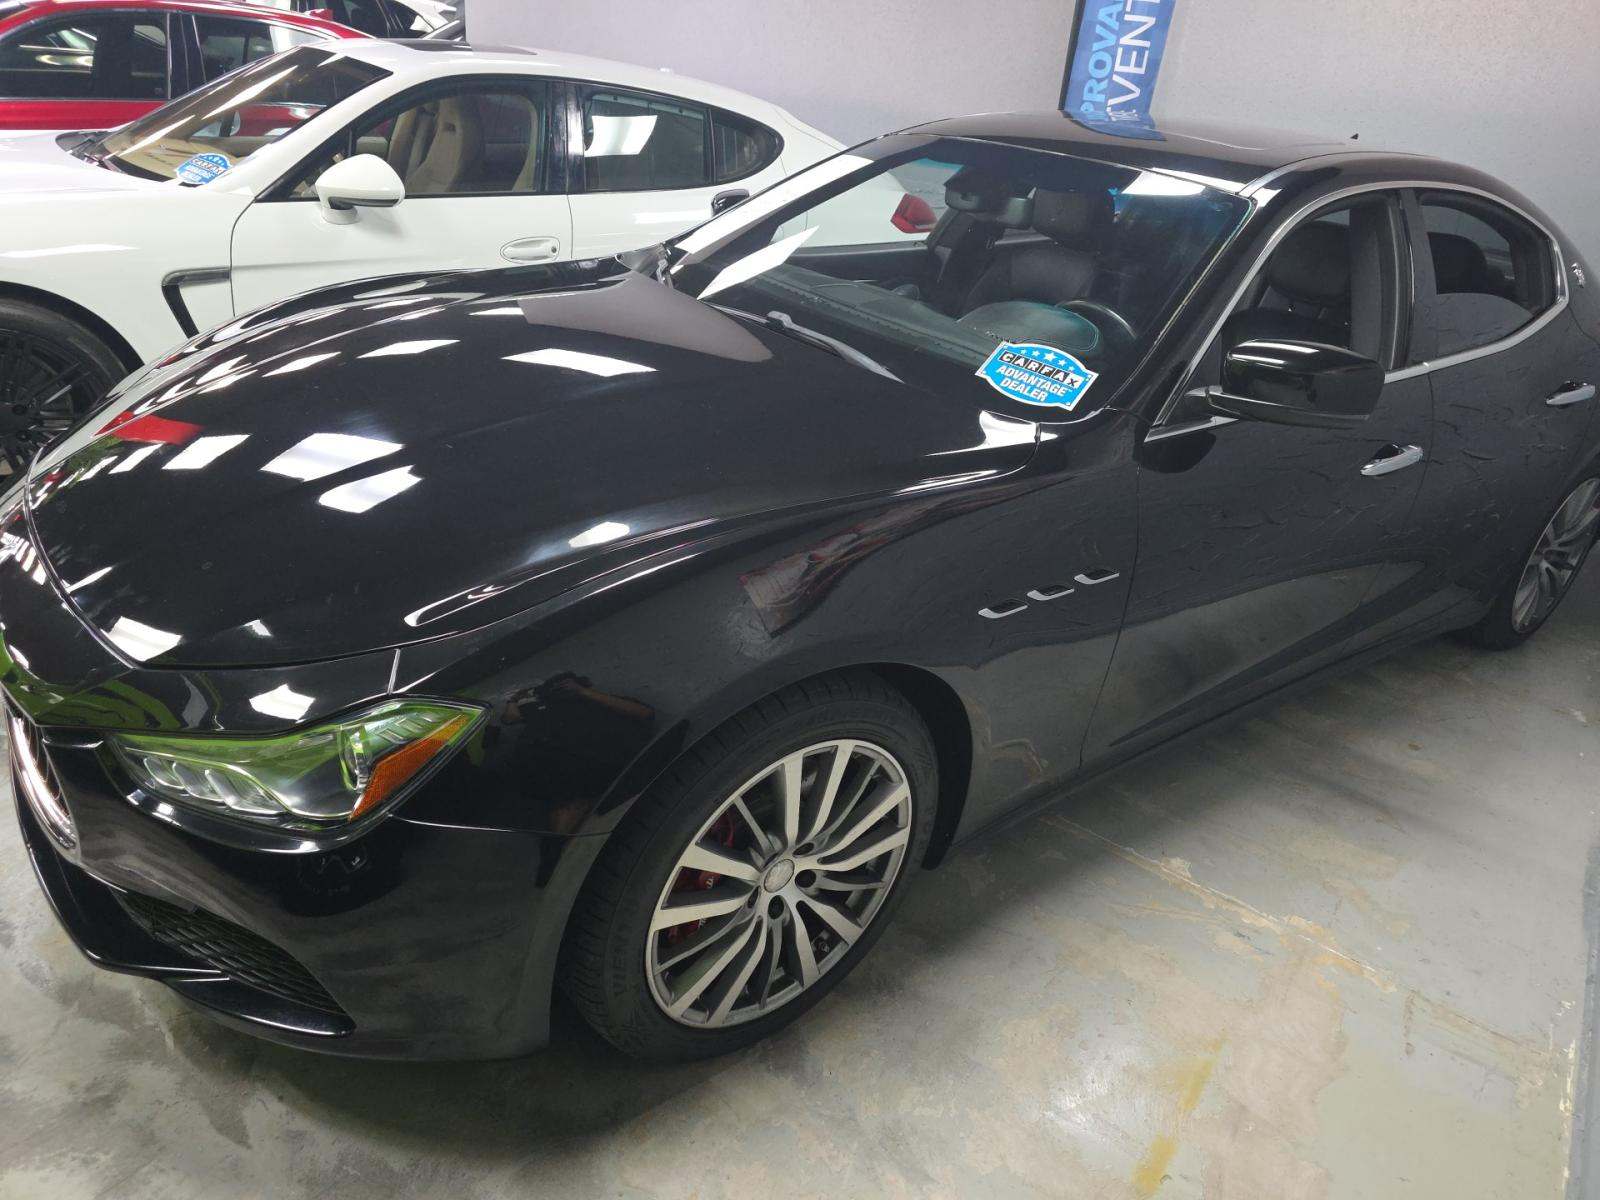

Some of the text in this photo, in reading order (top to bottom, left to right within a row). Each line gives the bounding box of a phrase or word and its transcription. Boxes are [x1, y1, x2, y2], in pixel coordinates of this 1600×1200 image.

[1080, 0, 1124, 119] PROVA
[995, 365, 1069, 396] ADVANTAGE
[1000, 351, 1083, 388] CARFAX
[1000, 377, 1048, 402] DEALER
